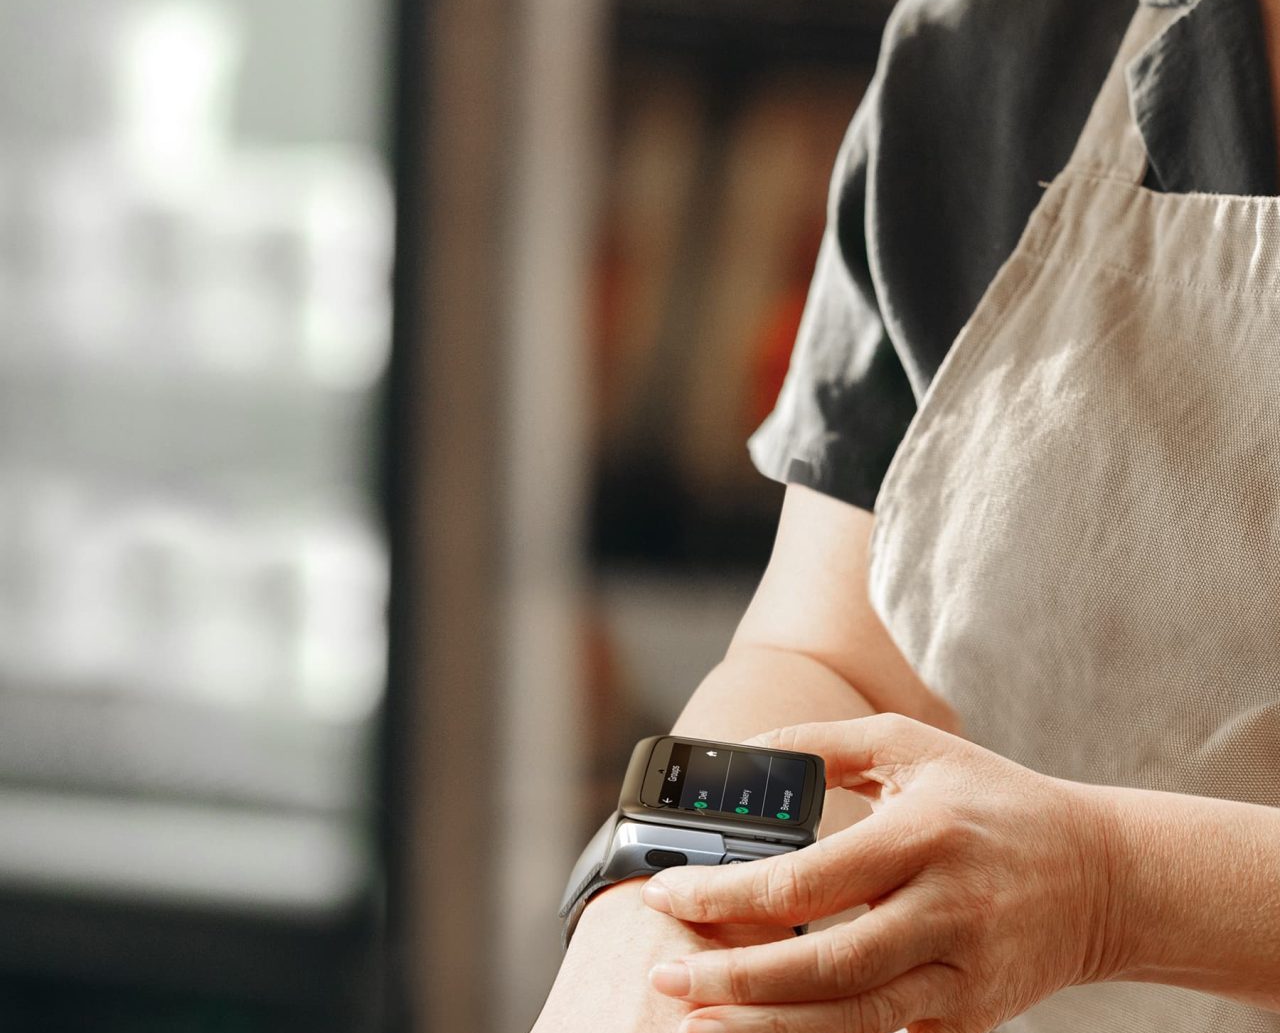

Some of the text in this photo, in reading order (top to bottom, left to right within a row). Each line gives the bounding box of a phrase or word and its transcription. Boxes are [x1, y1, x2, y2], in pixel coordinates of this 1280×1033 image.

[667, 765, 681, 783] Groups
[698, 790, 709, 800] Deli
[739, 789, 752, 806] Bakery
[780, 790, 794, 811] Beverage
